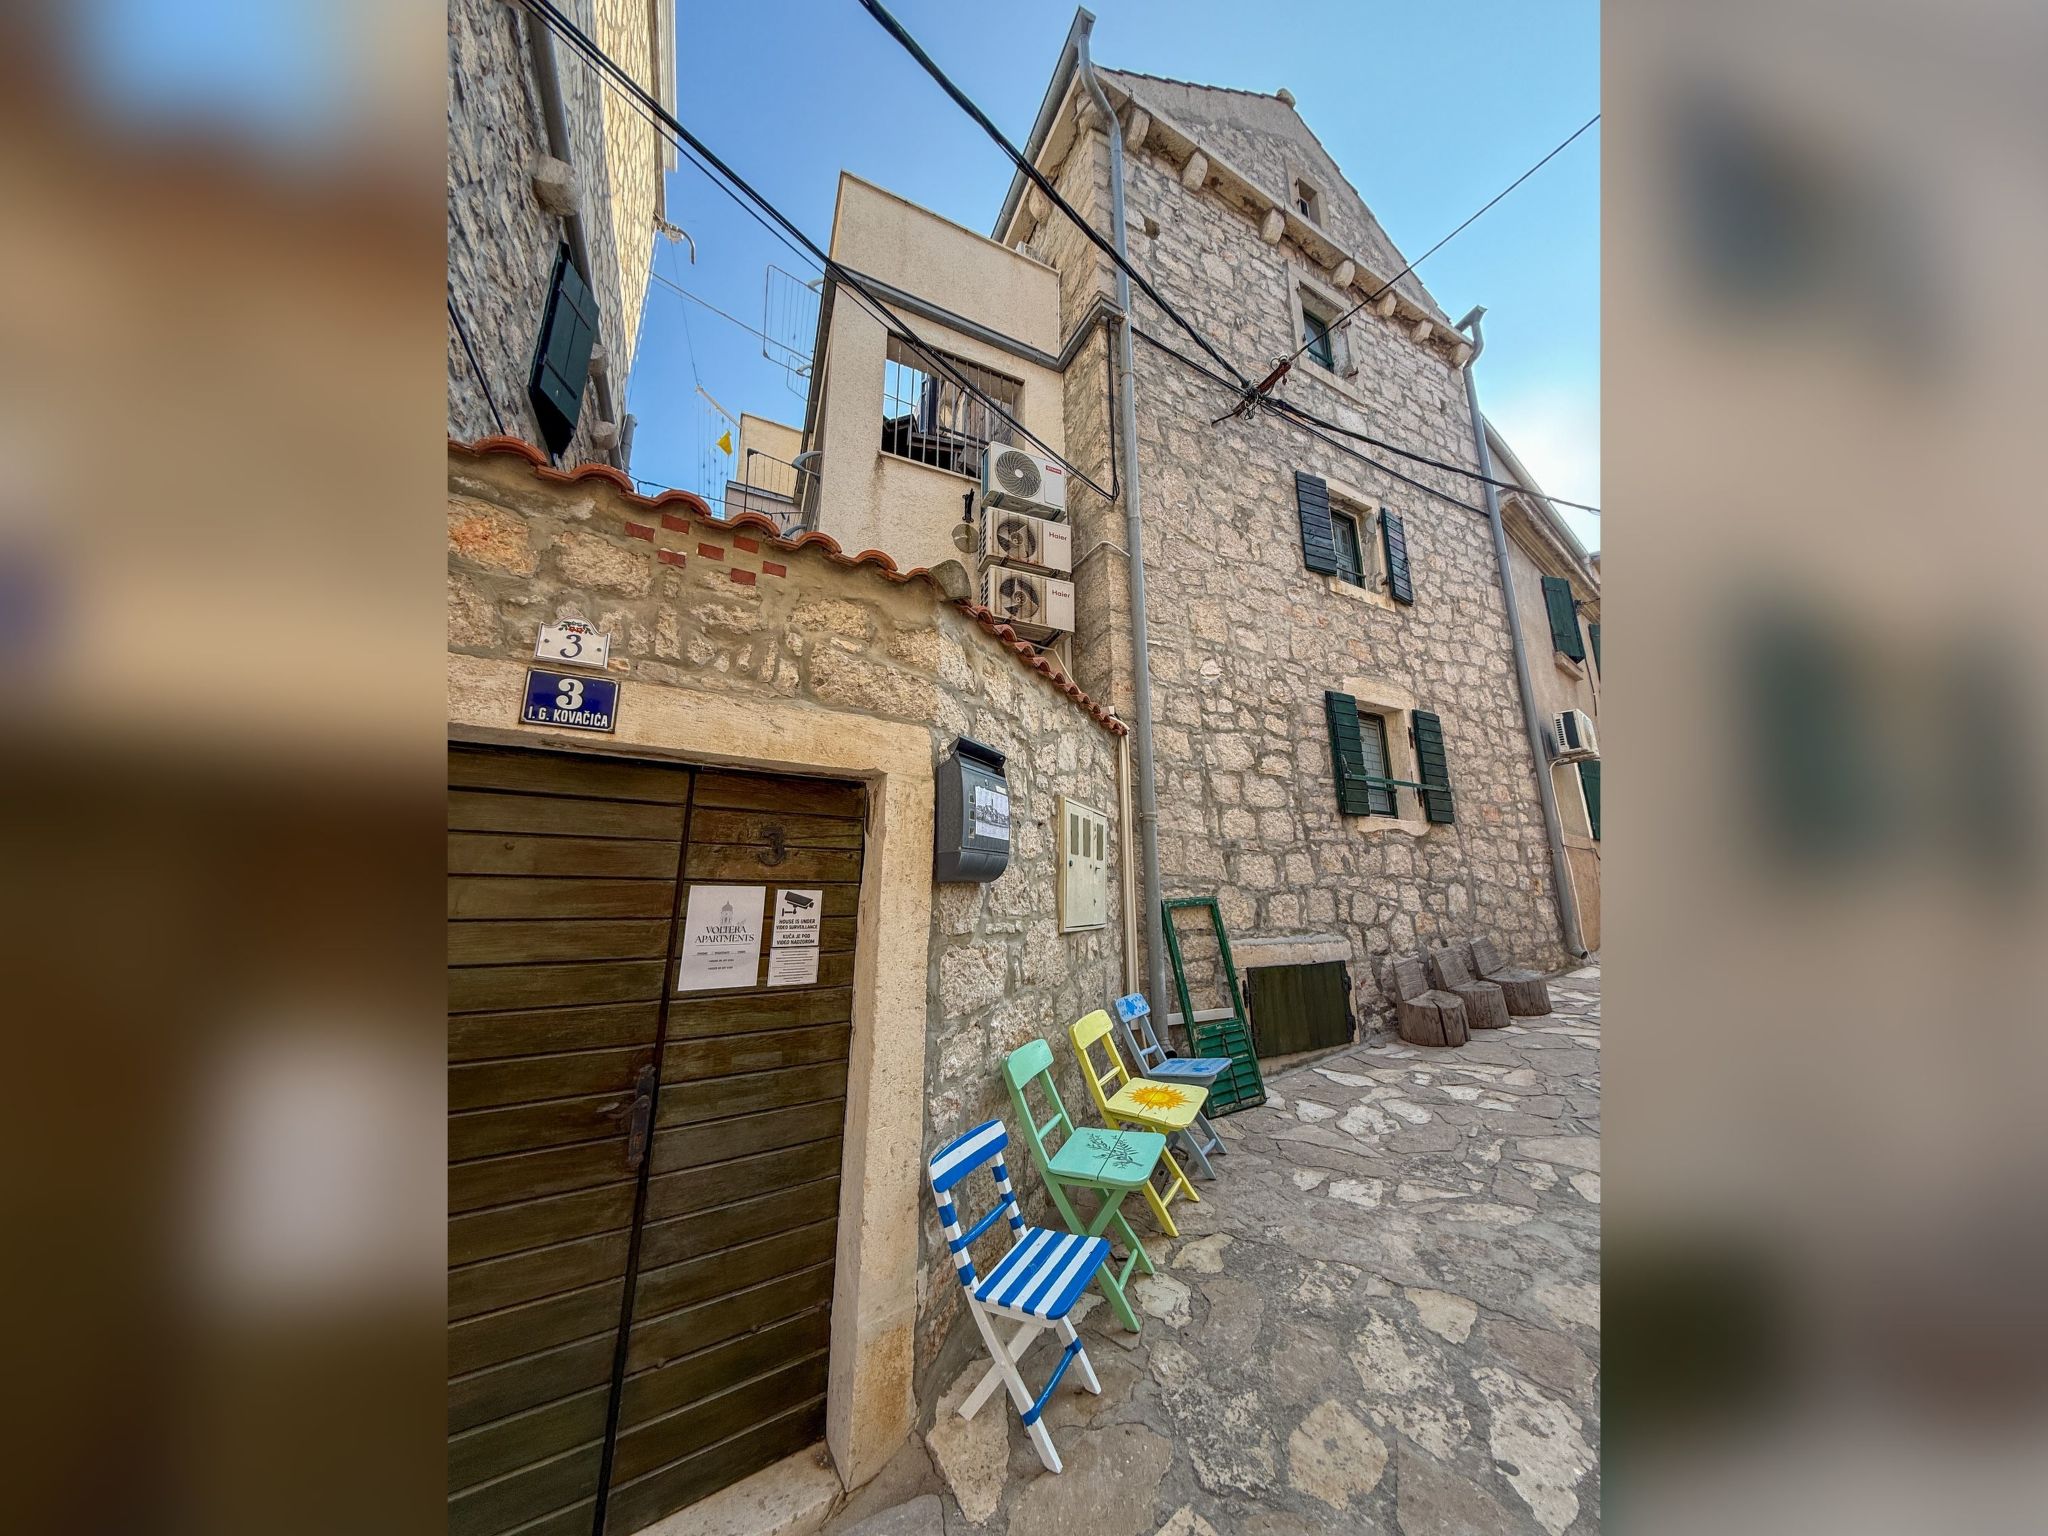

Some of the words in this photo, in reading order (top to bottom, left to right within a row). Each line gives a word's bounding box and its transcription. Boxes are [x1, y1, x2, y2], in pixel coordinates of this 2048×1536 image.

[1049, 531, 1067, 541] Haier
[1052, 589, 1070, 598] Haier
[560, 634, 582, 658] 3
[556, 678, 584, 710] 3
[528, 706, 535, 719] I.
[538, 707, 549, 720] G.
[553, 709, 608, 727] KOVAČIĆA
[760, 826, 785, 866] 3
[706, 925, 746, 934] VOLTERA
[695, 934, 755, 943] APARTMENTS
